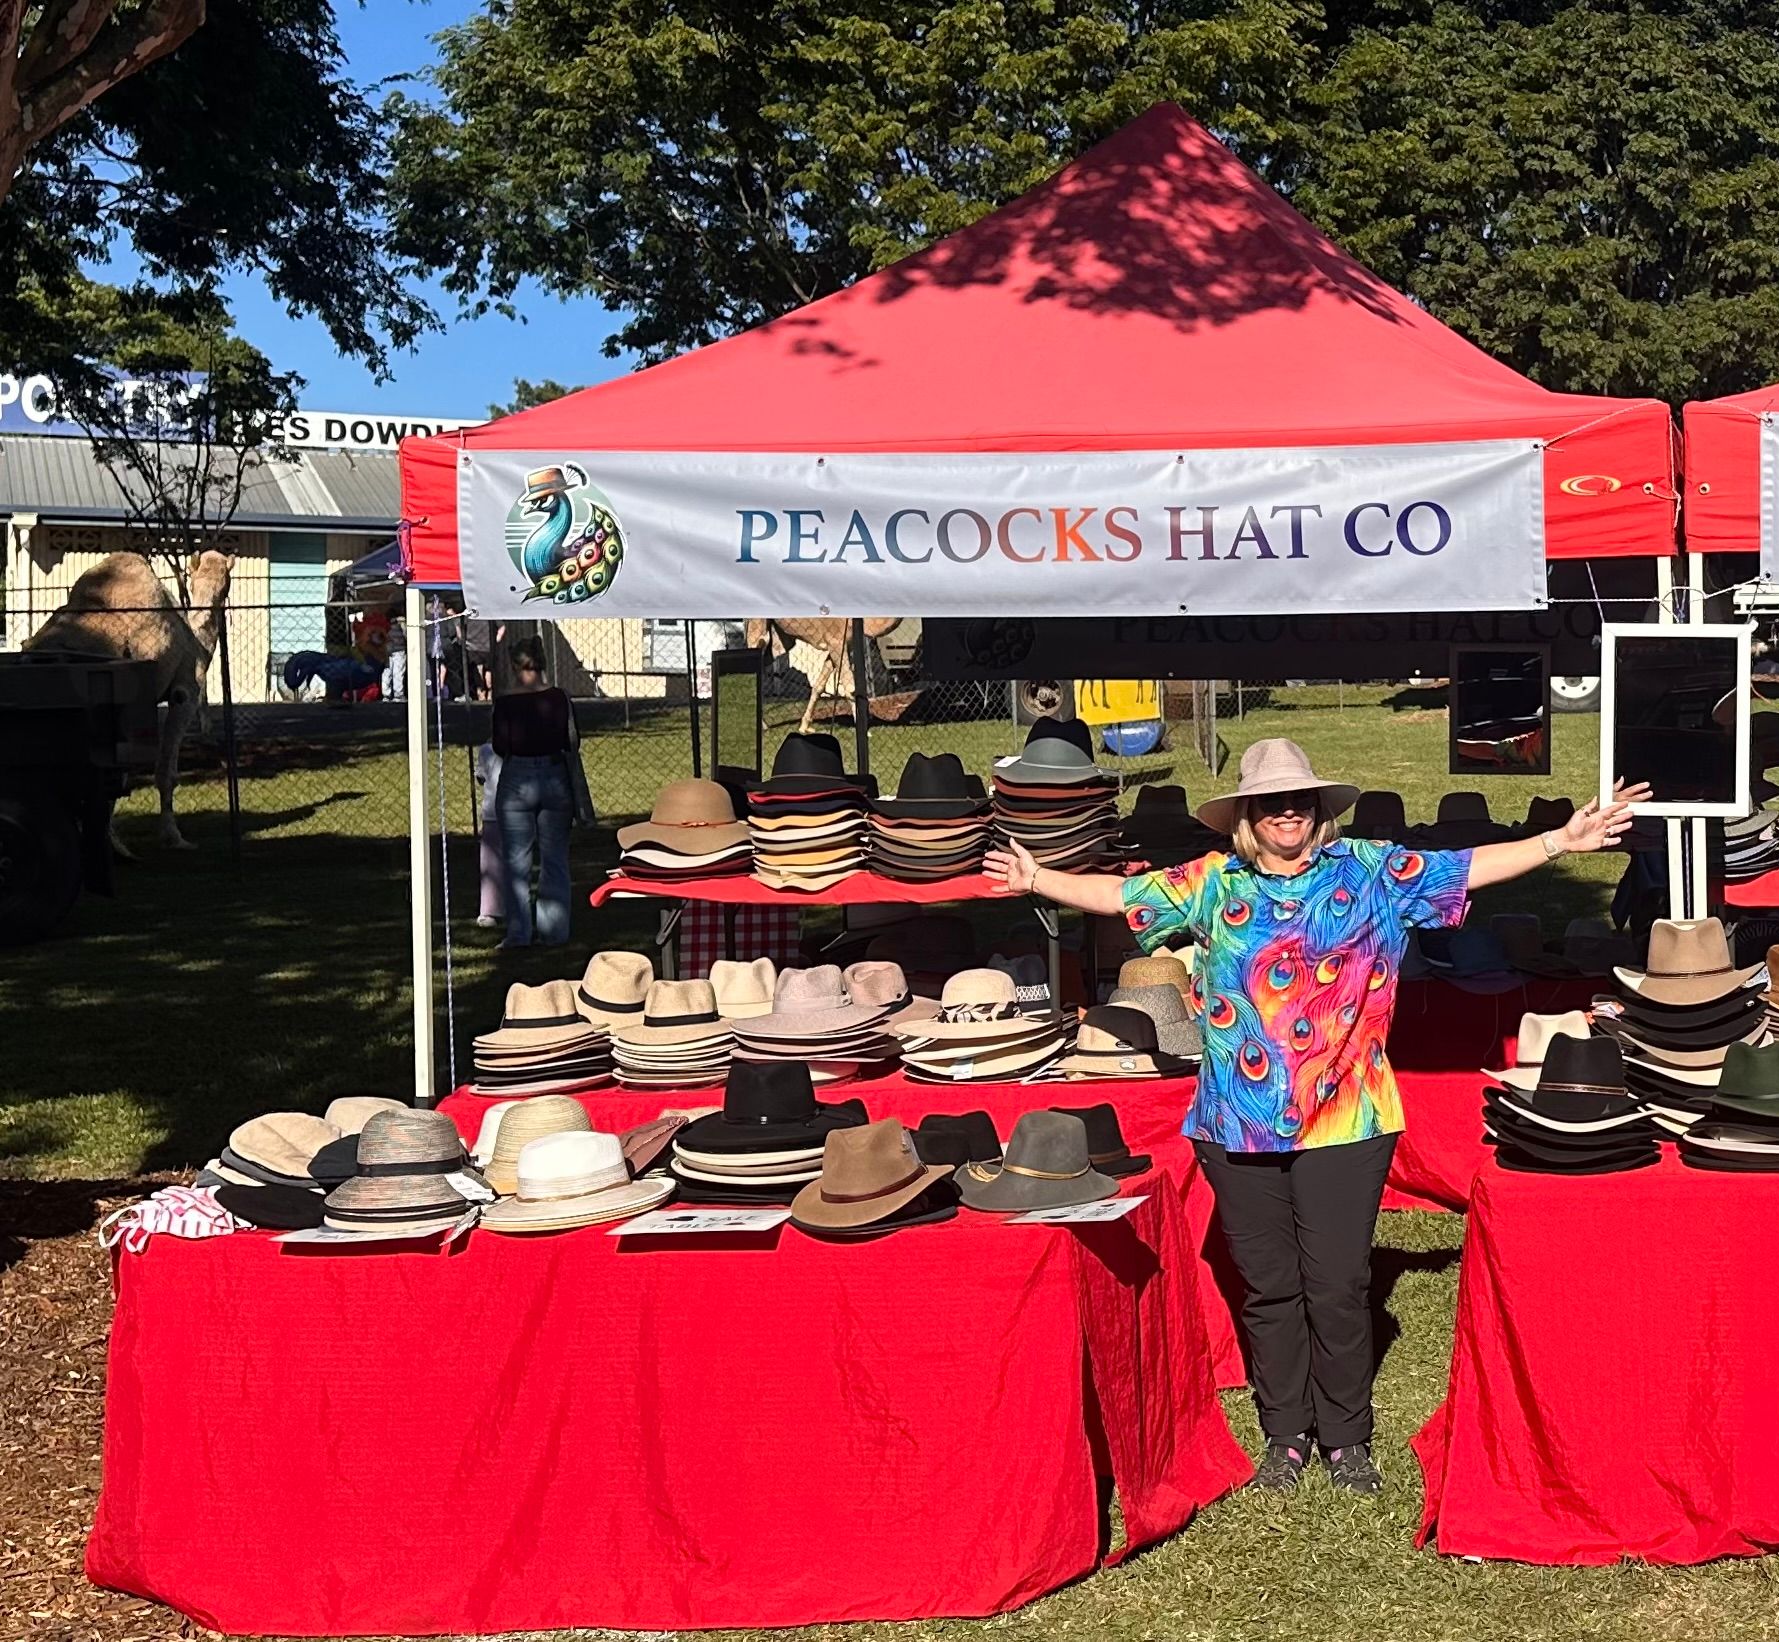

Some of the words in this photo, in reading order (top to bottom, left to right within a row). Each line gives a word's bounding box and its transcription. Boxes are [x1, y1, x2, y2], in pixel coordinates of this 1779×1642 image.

[735, 506, 1142, 564] PEACOCKS
[1164, 504, 1322, 562] HAT
[1343, 501, 1452, 557] CO
